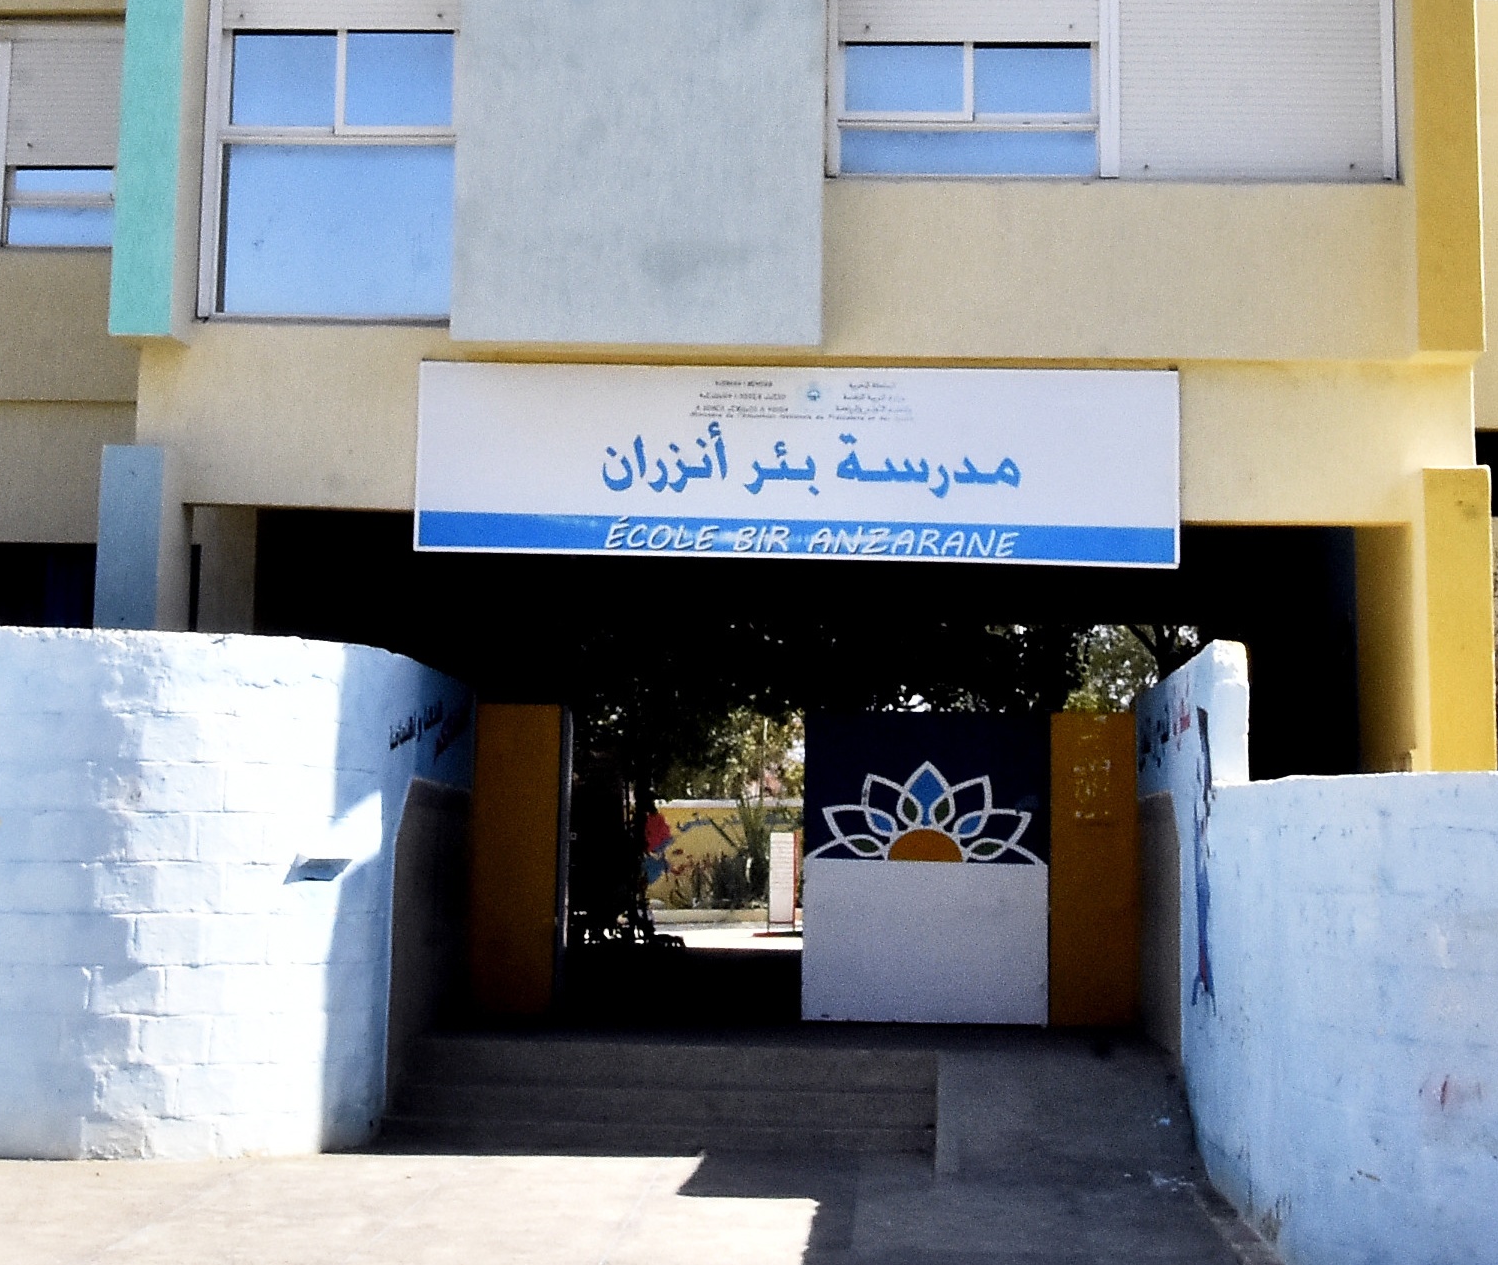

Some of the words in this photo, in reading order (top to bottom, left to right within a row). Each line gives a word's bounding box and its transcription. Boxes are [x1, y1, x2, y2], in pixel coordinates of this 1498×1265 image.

[601, 419, 730, 493] أنزران
[743, 440, 819, 496] بئر
[834, 432, 1022, 499] مدرسة
[603, 516, 722, 553] ÉCOLE
[732, 526, 792, 554] BIR
[807, 527, 1021, 559] ANZARANE
